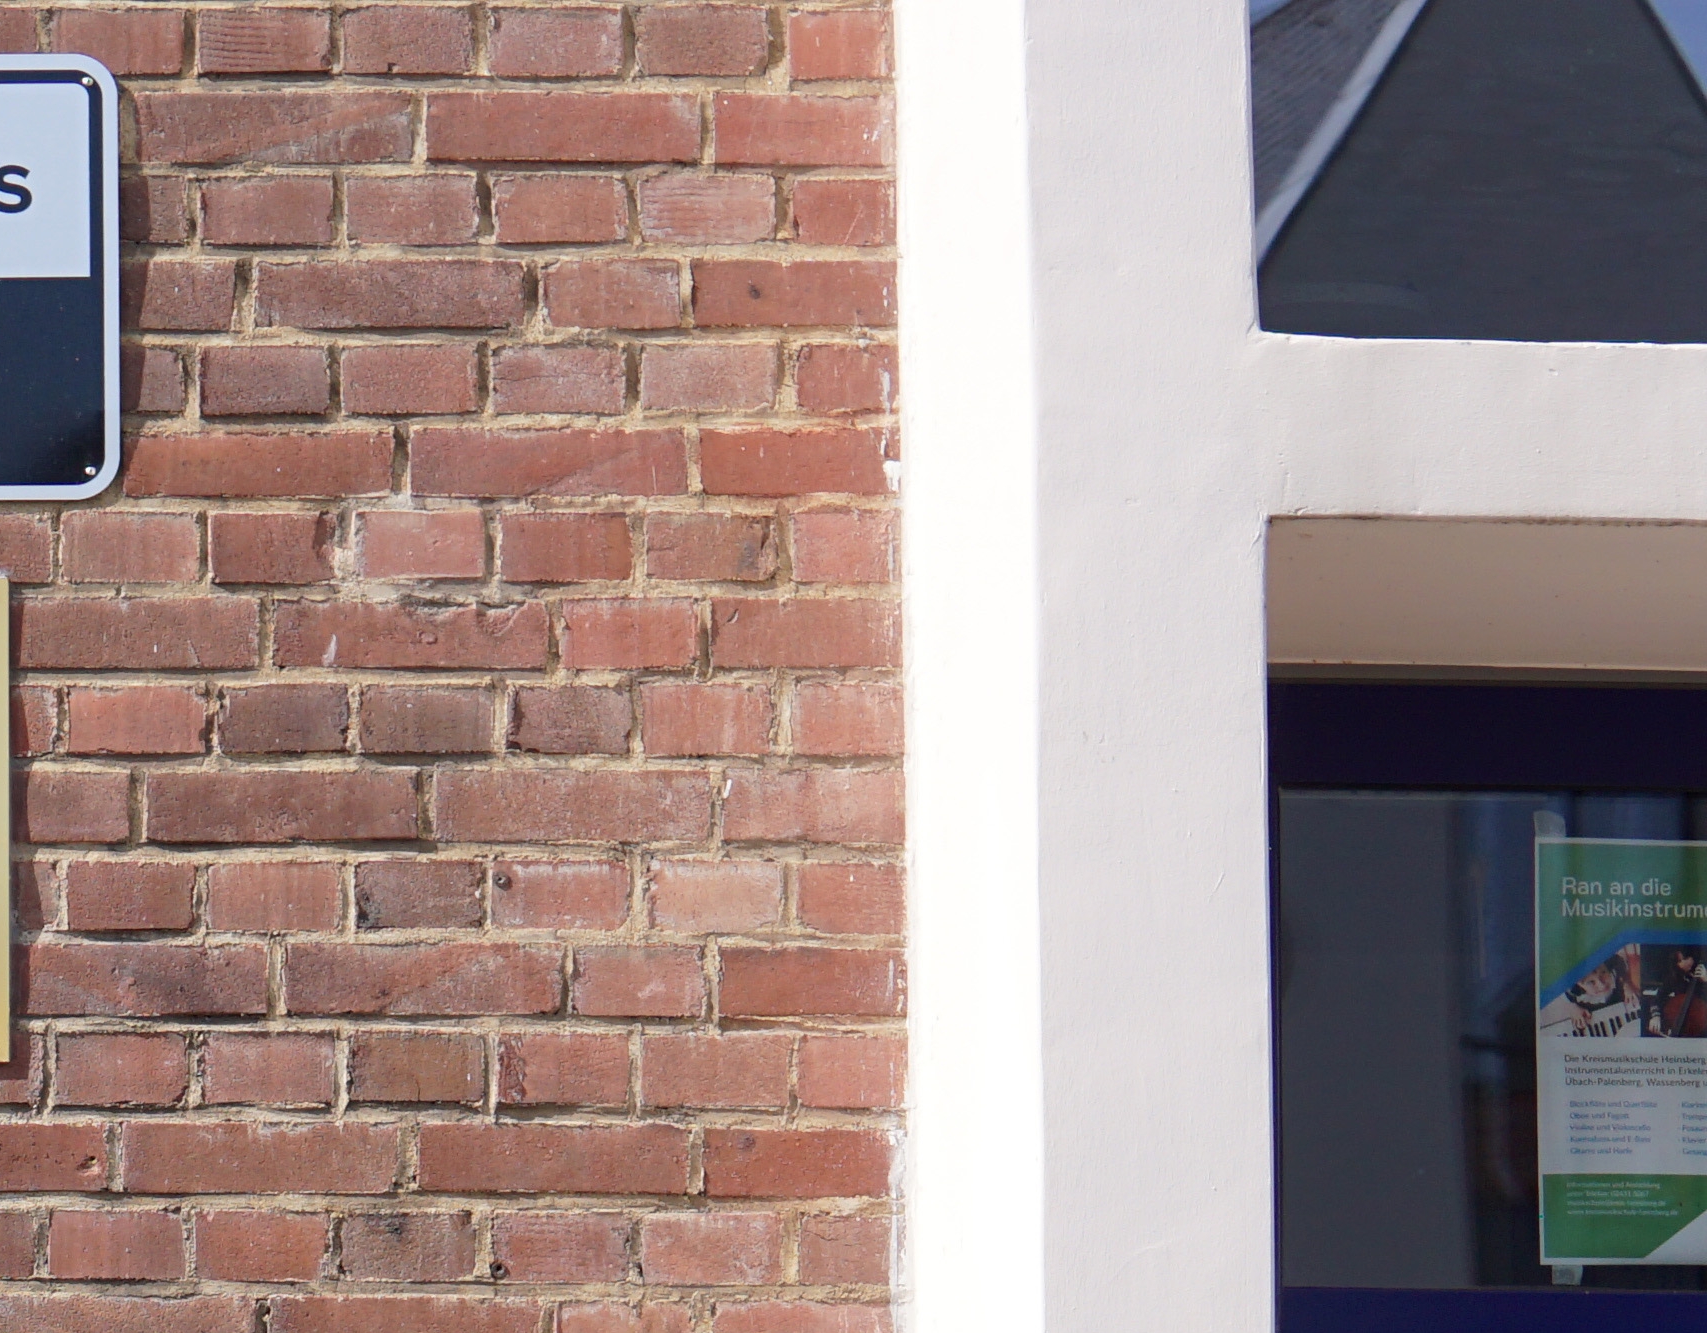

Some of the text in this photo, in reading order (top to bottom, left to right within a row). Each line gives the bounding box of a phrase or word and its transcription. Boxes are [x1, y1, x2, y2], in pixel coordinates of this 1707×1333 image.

[1561, 877, 1671, 896] Ran an die
[1564, 1054, 1706, 1066] Die Kreismusikschule Heinsberg
[1564, 1066, 1665, 1075] Instrumentalunterricht
[1667, 1066, 1675, 1074] in
[1646, 1078, 1700, 1088] Wassenberg
